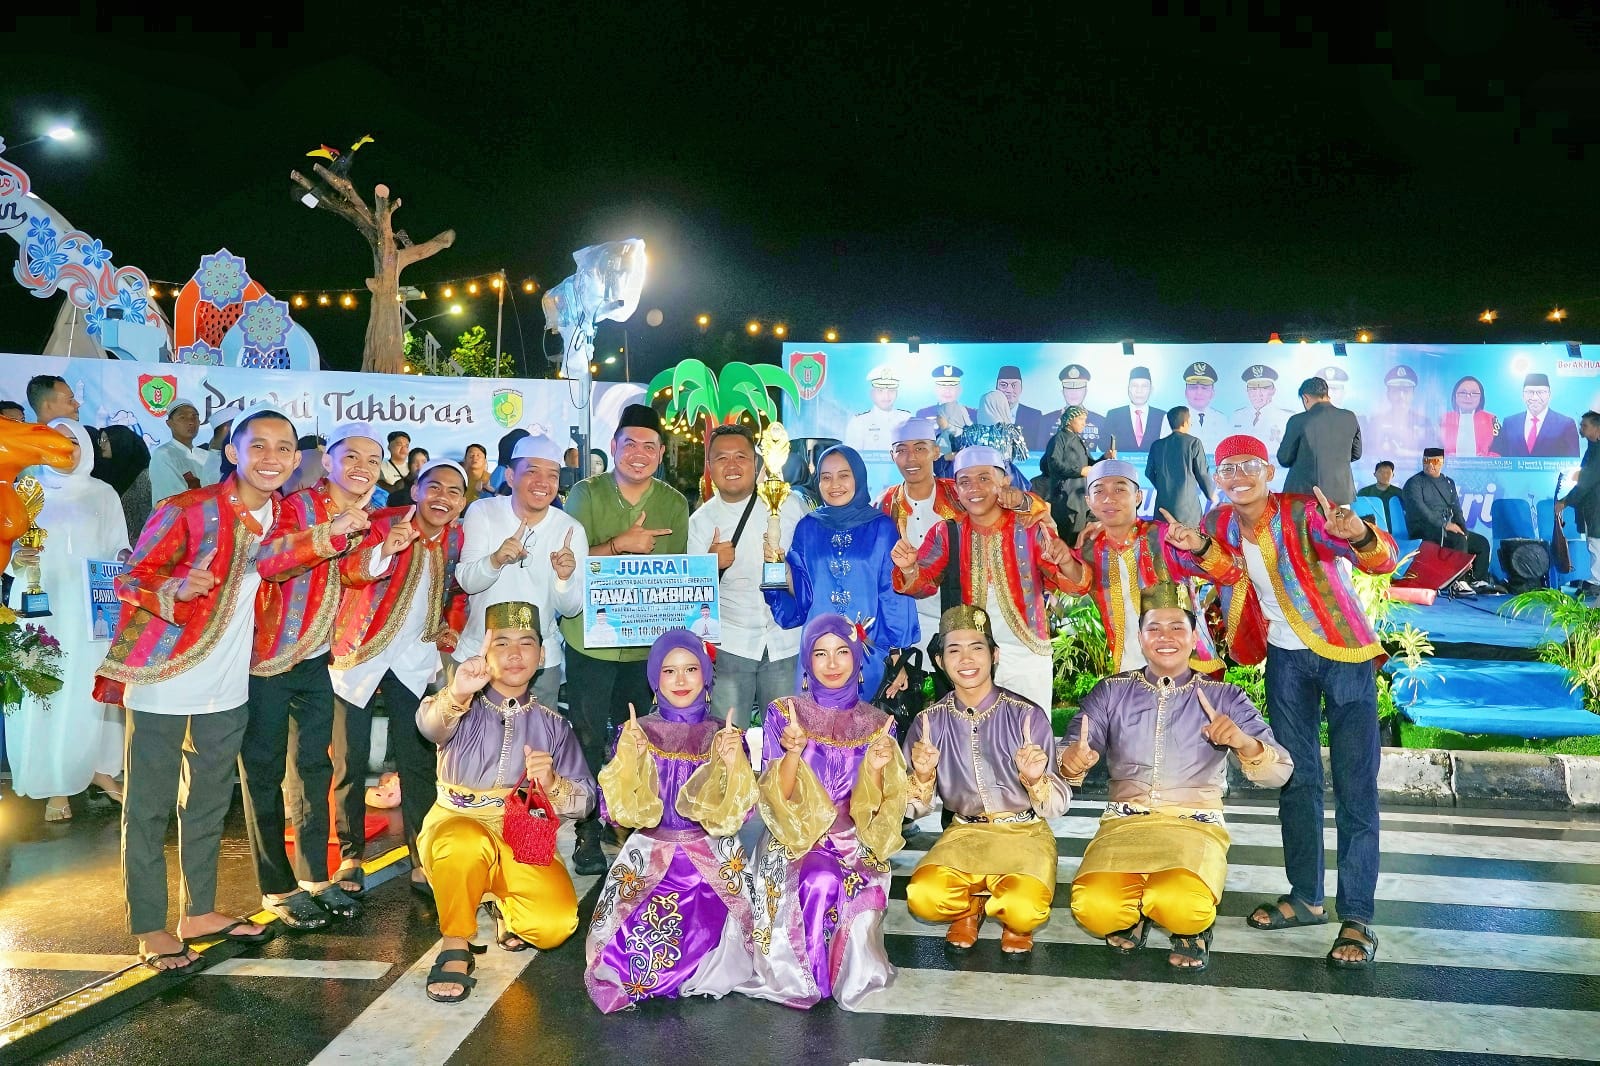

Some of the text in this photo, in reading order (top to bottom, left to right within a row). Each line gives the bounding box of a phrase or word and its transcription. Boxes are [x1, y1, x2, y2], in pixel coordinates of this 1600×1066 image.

[323, 389, 474, 424] Takbiran
[616, 560, 688, 575] JUARA I
[590, 586, 715, 605] PAWAI TAKBIRAN
